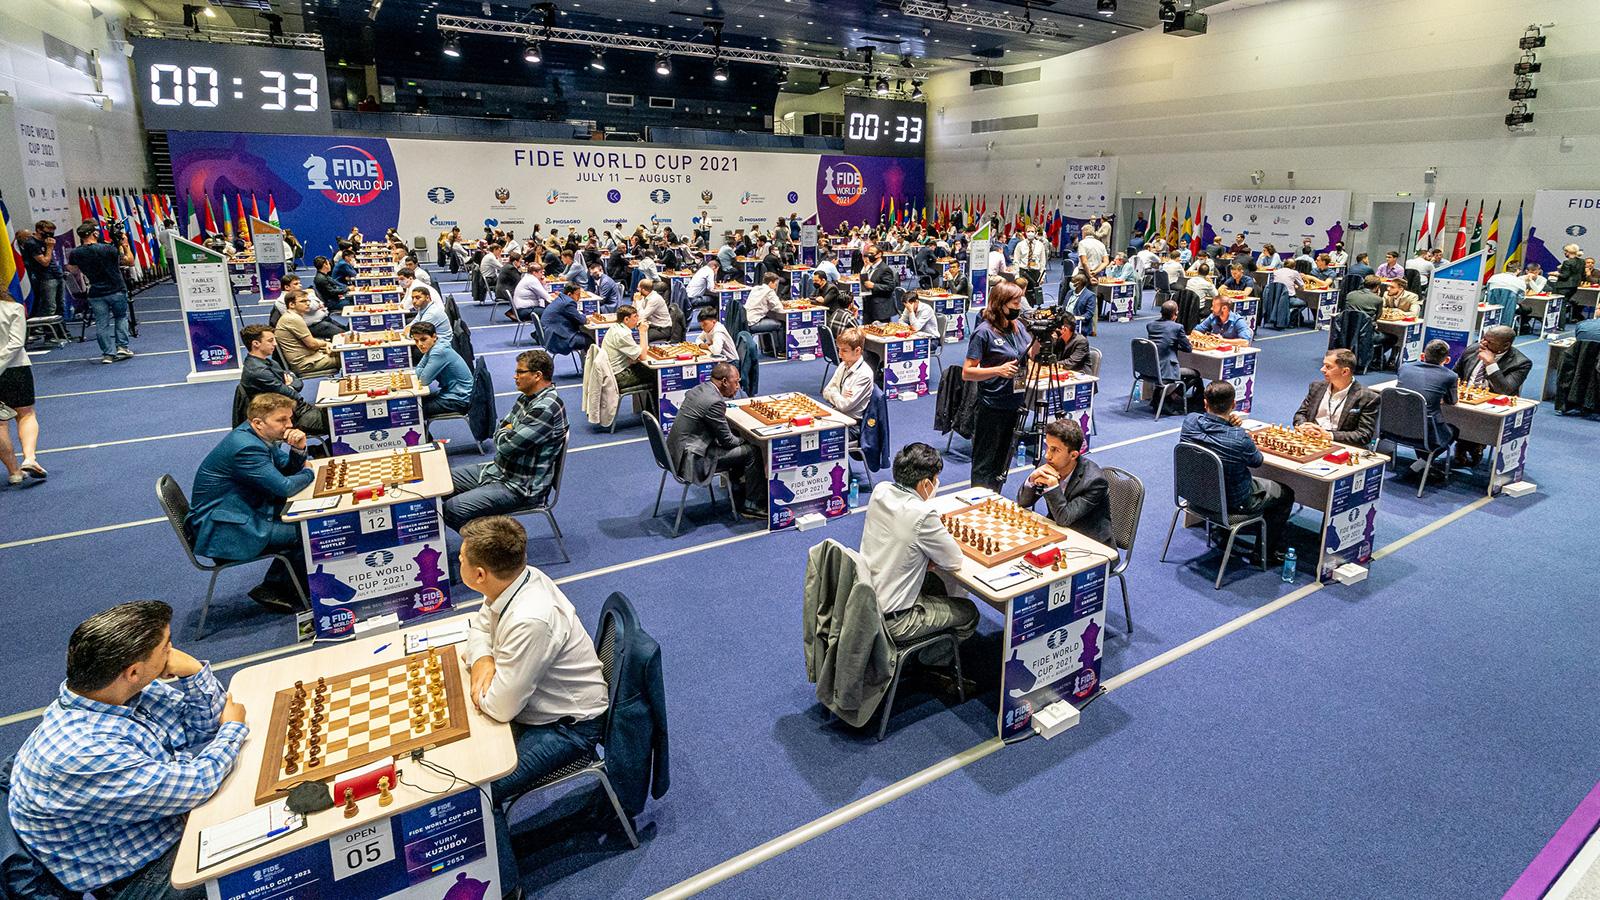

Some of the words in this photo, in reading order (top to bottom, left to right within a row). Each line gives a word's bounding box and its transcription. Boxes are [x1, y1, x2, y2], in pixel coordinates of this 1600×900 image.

[514, 150, 564, 168] FIDE
[573, 151, 646, 169] WORLD
[655, 154, 692, 170] CUP
[700, 156, 739, 172] 2021
[332, 159, 378, 177] FIDE
[576, 173, 604, 182] JULY
[610, 173, 619, 182] 11
[639, 174, 684, 184] AUGUST
[686, 175, 692, 184] 8
[836, 172, 860, 185] FIDE
[335, 180, 371, 190] WORLD
[373, 180, 393, 192] CUP
[837, 187, 856, 195] WORLD
[336, 193, 361, 203] 2021
[836, 196, 850, 204] 2021
[1224, 195, 1242, 203] FIDE
[1300, 196, 1321, 204] 2021
[372, 408, 383, 416] 13
[377, 440, 402, 448] WORLD
[806, 440, 814, 449] 11
[791, 481, 805, 489] FIDE
[807, 476, 828, 485] WORLD
[1355, 479, 1362, 490] 07
[369, 517, 385, 530] 12
[348, 573, 372, 583] FIDE
[375, 564, 413, 576] WORLD
[357, 581, 379, 591] CUP
[383, 575, 405, 586] 2021
[1055, 580, 1066, 588] OPEN
[423, 592, 441, 600] FIDE
[1053, 590, 1066, 605] 06
[332, 612, 353, 622] FIDE
[1032, 655, 1050, 669] FIDE
[1052, 642, 1078, 659] WORLD
[1037, 665, 1054, 677] CUP
[1056, 656, 1072, 669] 2021
[1080, 674, 1094, 685] FIDE
[1014, 703, 1030, 717] FIDE
[437, 802, 452, 811] FIDE
[408, 828, 423, 836] FIDE
[425, 819, 447, 830] WORLD
[449, 814, 461, 822] CUP
[463, 808, 477, 817] 2021
[346, 827, 377, 843] OPEN
[434, 834, 458, 846] YURIY
[425, 837, 467, 858] KUZUBOV
[347, 841, 381, 869] 05
[447, 855, 465, 866] 2653
[263, 864, 280, 874] FIDE
[248, 883, 275, 896] WORLD
[277, 876, 293, 886] CUP
[294, 869, 311, 879] 2021
